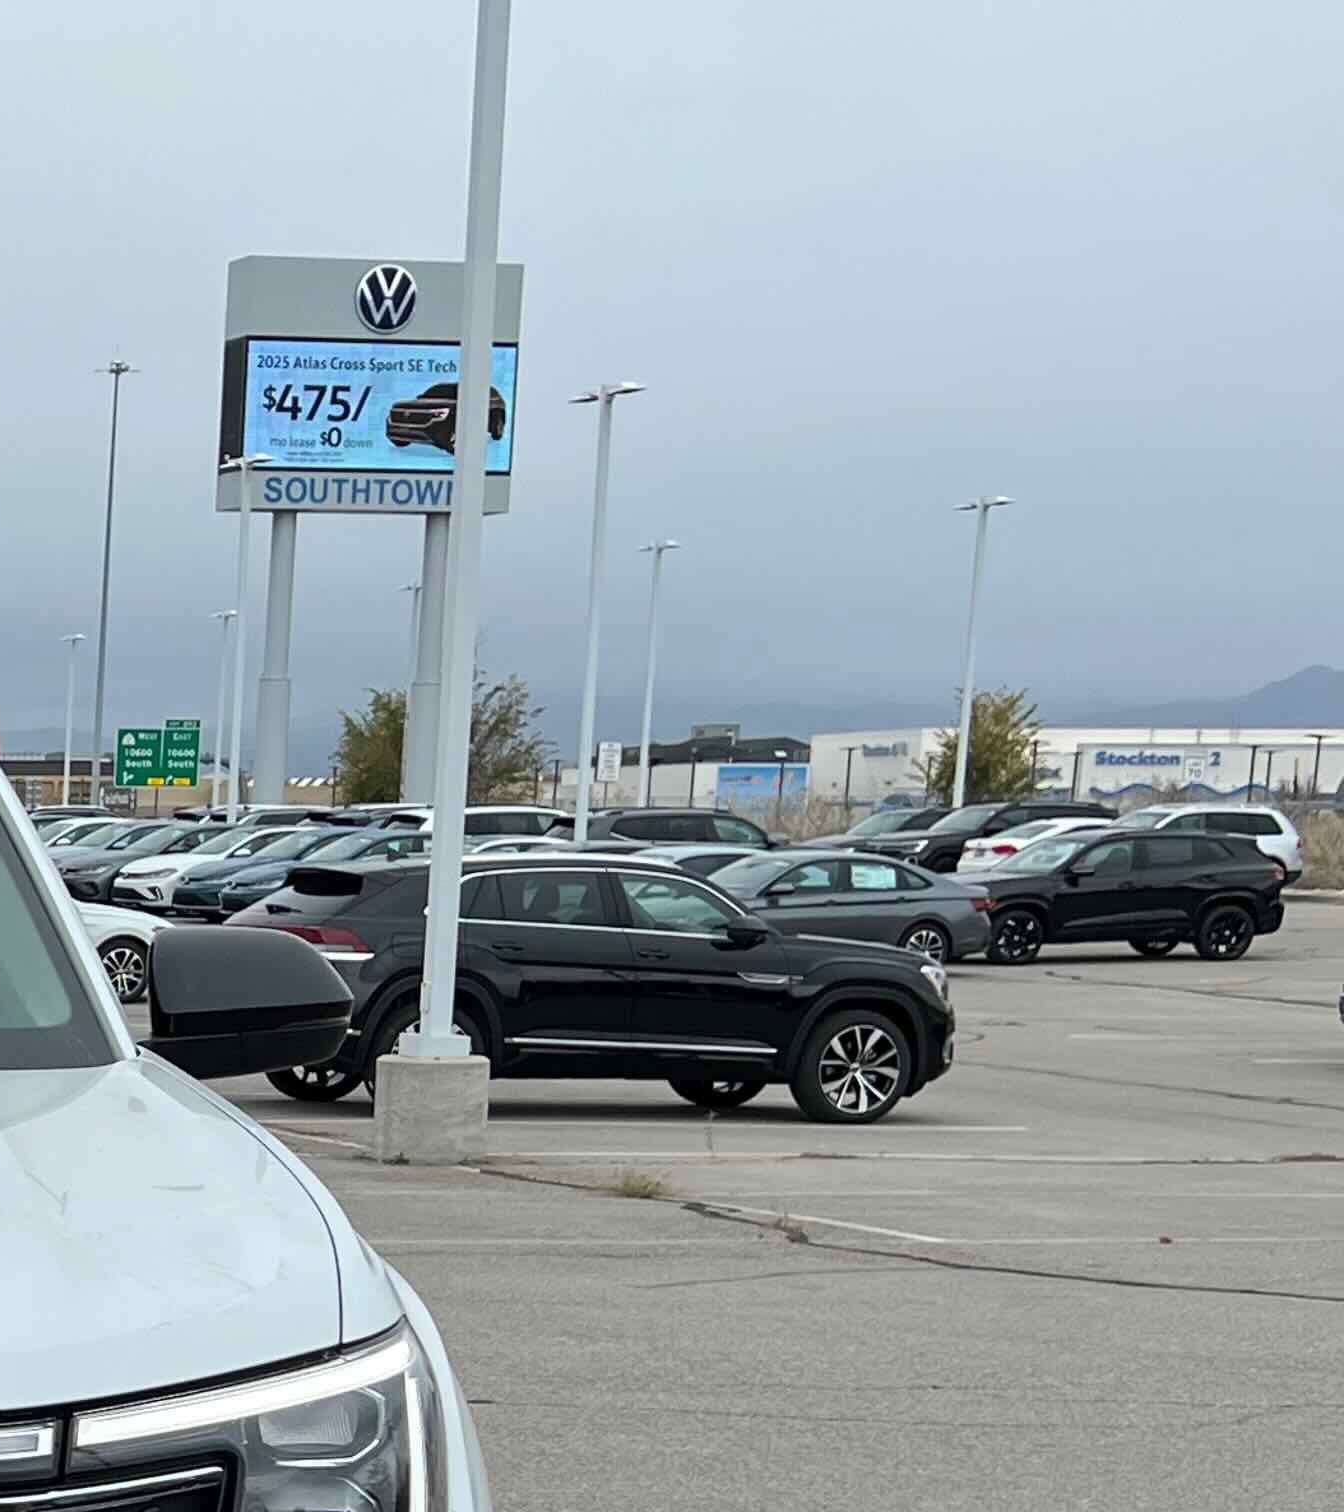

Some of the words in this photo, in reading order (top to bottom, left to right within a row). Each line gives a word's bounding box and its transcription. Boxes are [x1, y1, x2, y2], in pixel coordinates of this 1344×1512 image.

[361, 266, 416, 326] VW
[257, 354, 290, 369] 2025
[293, 356, 327, 370] Atlas
[330, 357, 365, 371] Cross
[368, 357, 404, 374] Sport
[407, 359, 423, 373] SE
[428, 359, 457, 374] Tech
[262, 384, 372, 422] $475/
[289, 437, 316, 448] lease
[320, 427, 342, 448] $0
[343, 437, 373, 448] down
[264, 477, 453, 506] SOUTHTOW
[167, 759, 195, 768] South
[1095, 751, 1181, 766] Stockton
